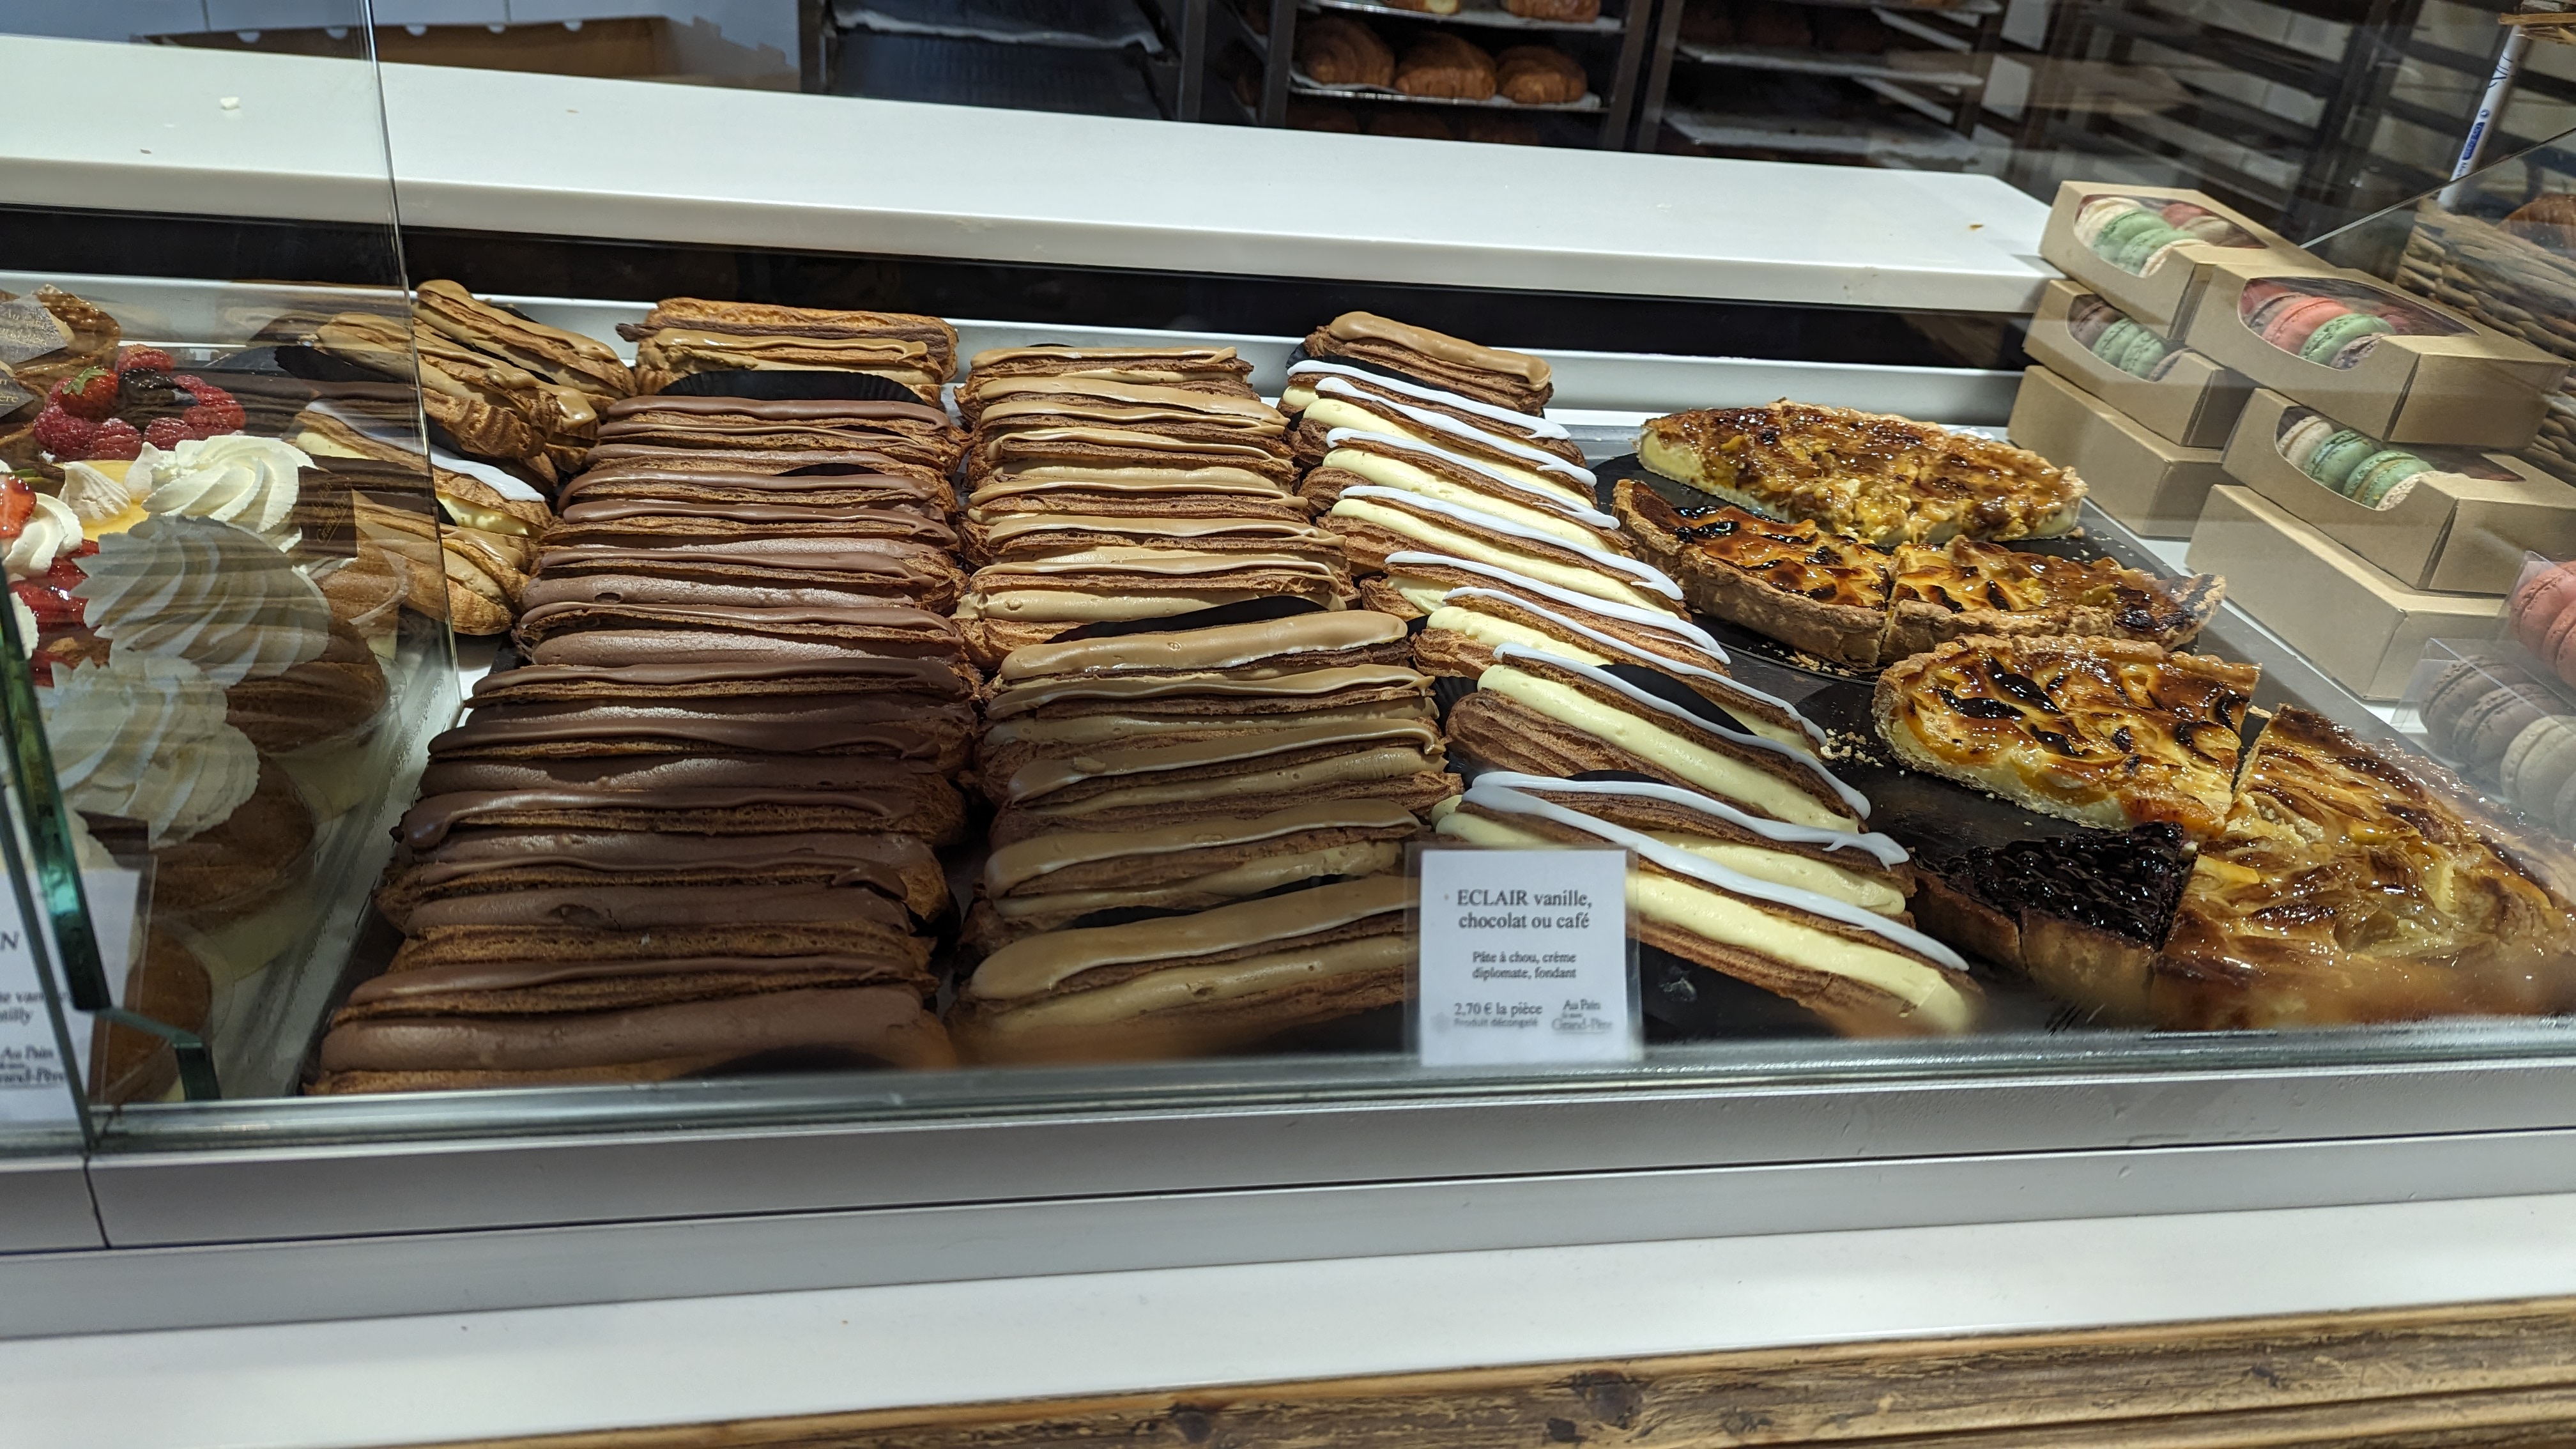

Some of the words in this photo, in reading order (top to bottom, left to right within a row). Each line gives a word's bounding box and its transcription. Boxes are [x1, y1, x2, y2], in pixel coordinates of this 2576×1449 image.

[1457, 889, 1529, 906] ECLAIR
[1534, 889, 1592, 908] vanille,
[1459, 912, 1526, 929] chocolat
[1531, 916, 1552, 929] ou
[1556, 912, 1590, 929] café
[1473, 951, 1496, 963] Pâte
[1499, 951, 1506, 963] à
[1508, 951, 1540, 965] chou,
[1542, 951, 1576, 963] crème
[1472, 967, 1532, 981] diplomate,
[1535, 967, 1576, 979] fondant
[1454, 1002, 1482, 1016] 2,70
[1483, 1002, 1492, 1015] €
[1496, 1002, 1508, 1015] la
[1510, 1002, 1543, 1017] pièce
